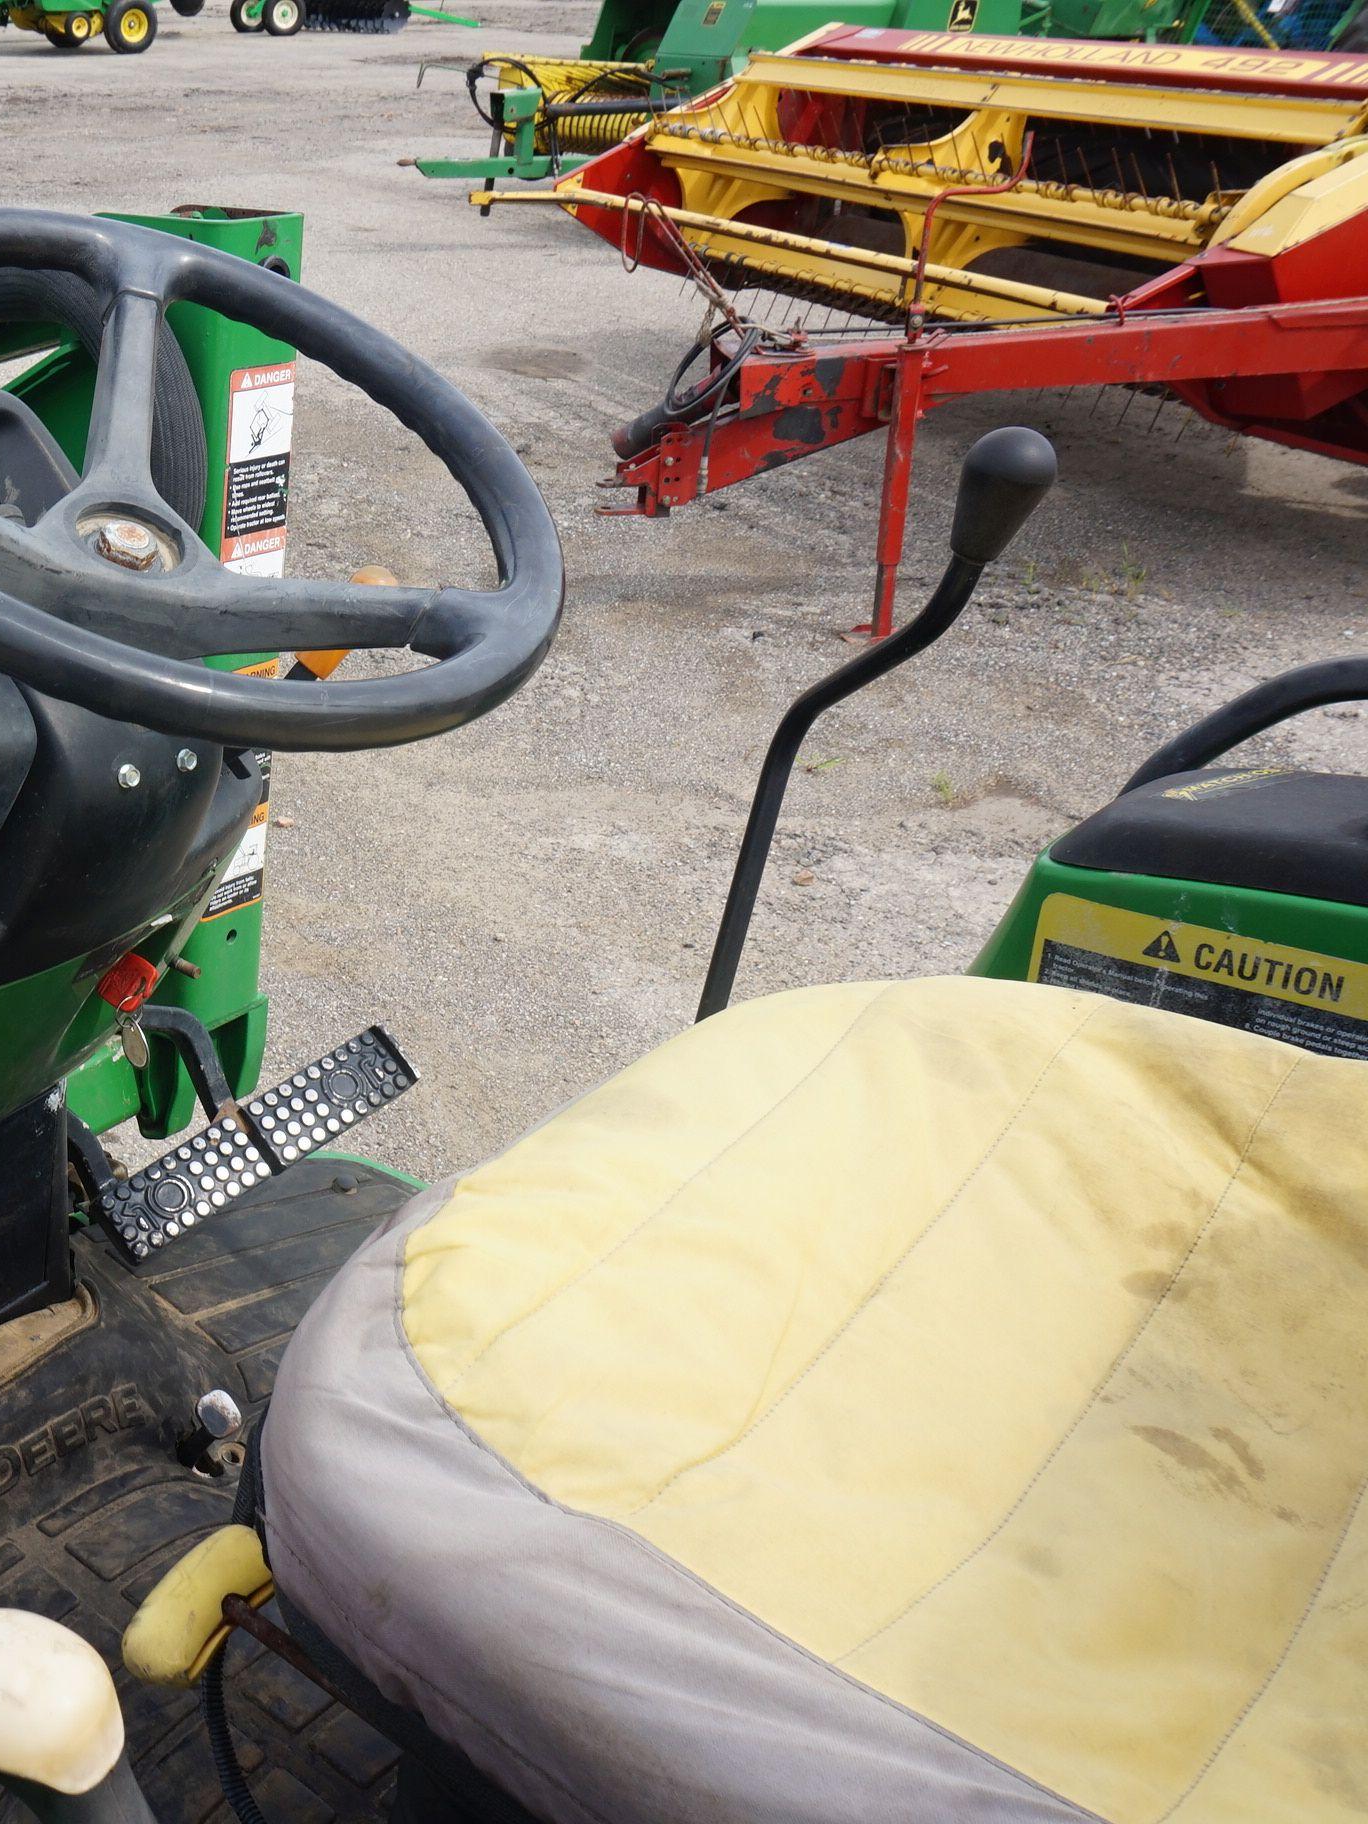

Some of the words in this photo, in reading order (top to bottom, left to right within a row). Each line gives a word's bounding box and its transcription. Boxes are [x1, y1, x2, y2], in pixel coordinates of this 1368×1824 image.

[1199, 55, 1303, 75] 492
[254, 369, 291, 386] DANGER
[245, 538, 280, 556] DANGER
[1194, 943, 1345, 1003] CAUTION
